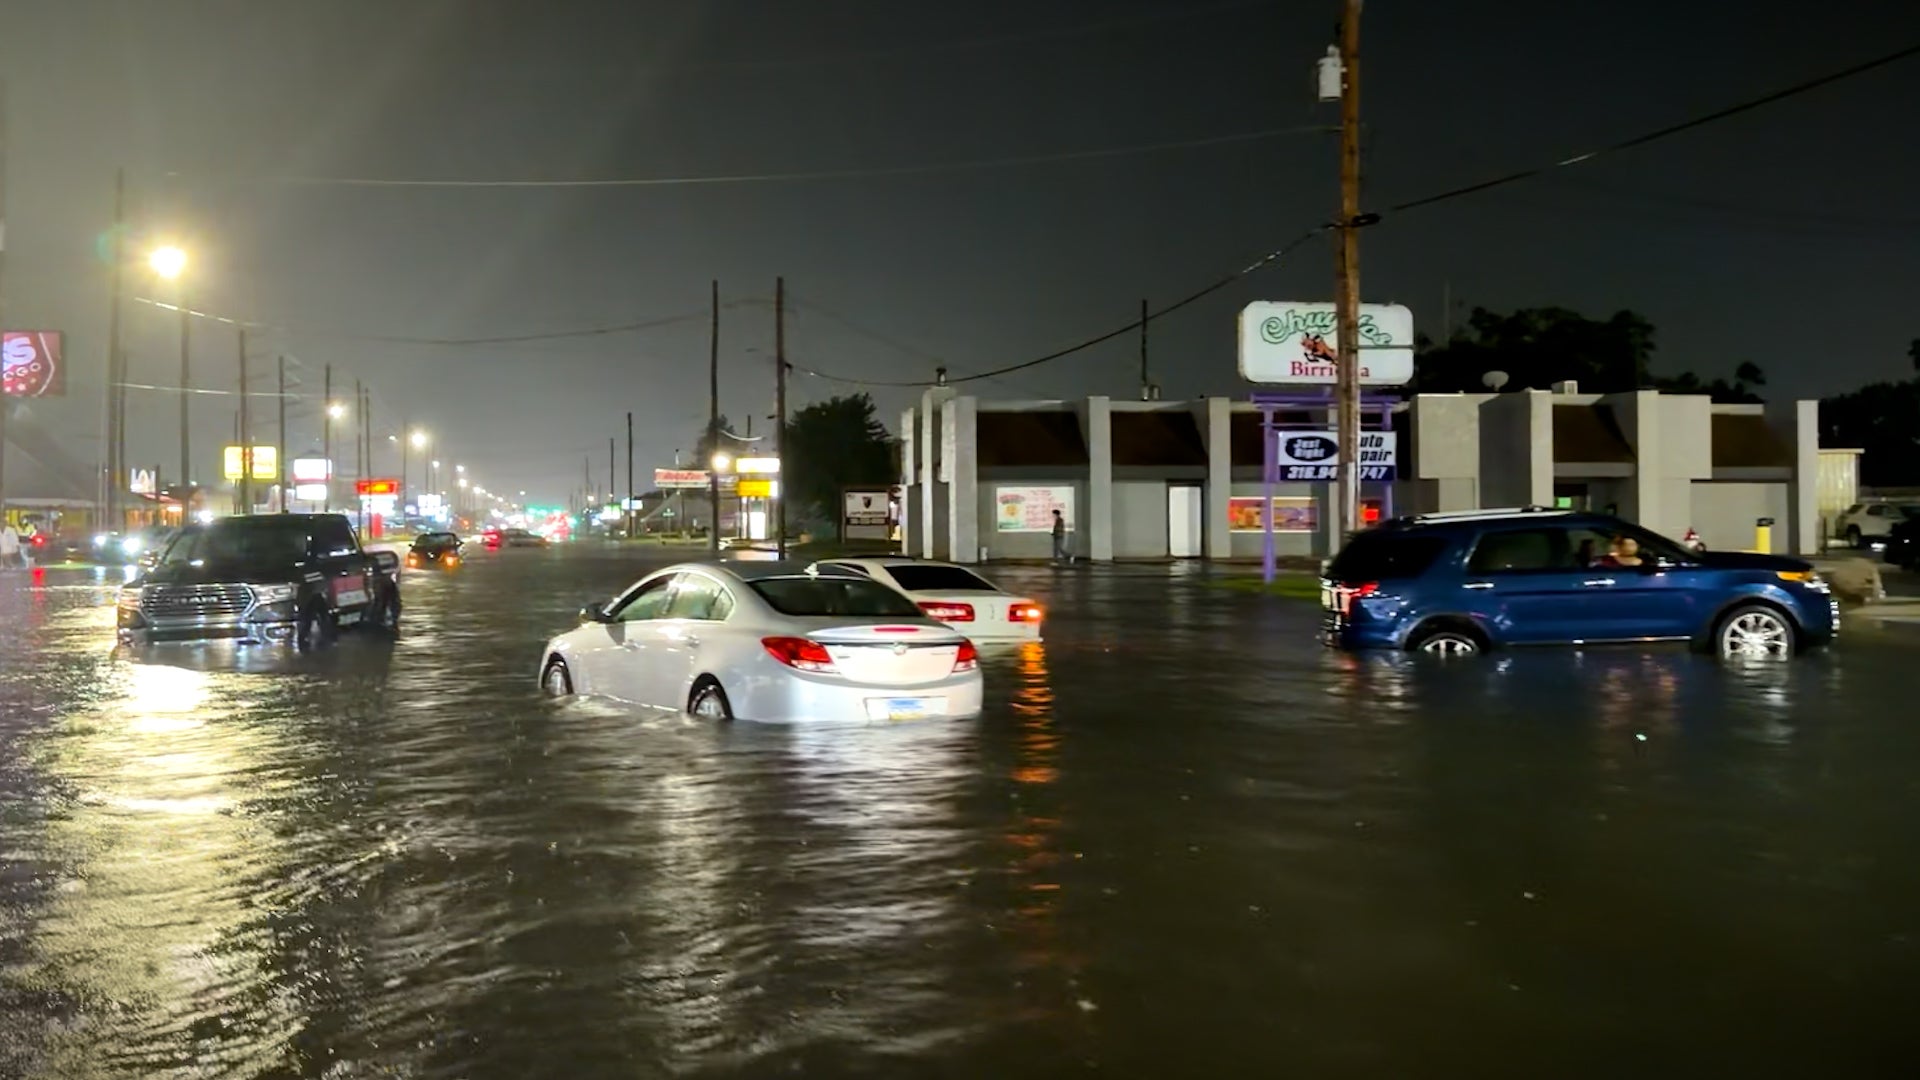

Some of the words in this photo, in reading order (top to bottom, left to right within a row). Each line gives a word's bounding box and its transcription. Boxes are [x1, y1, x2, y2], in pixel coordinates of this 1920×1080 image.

[1291, 361, 1370, 376] Birria
[1360, 435, 1384, 448] uto
[1360, 449, 1392, 462] pair
